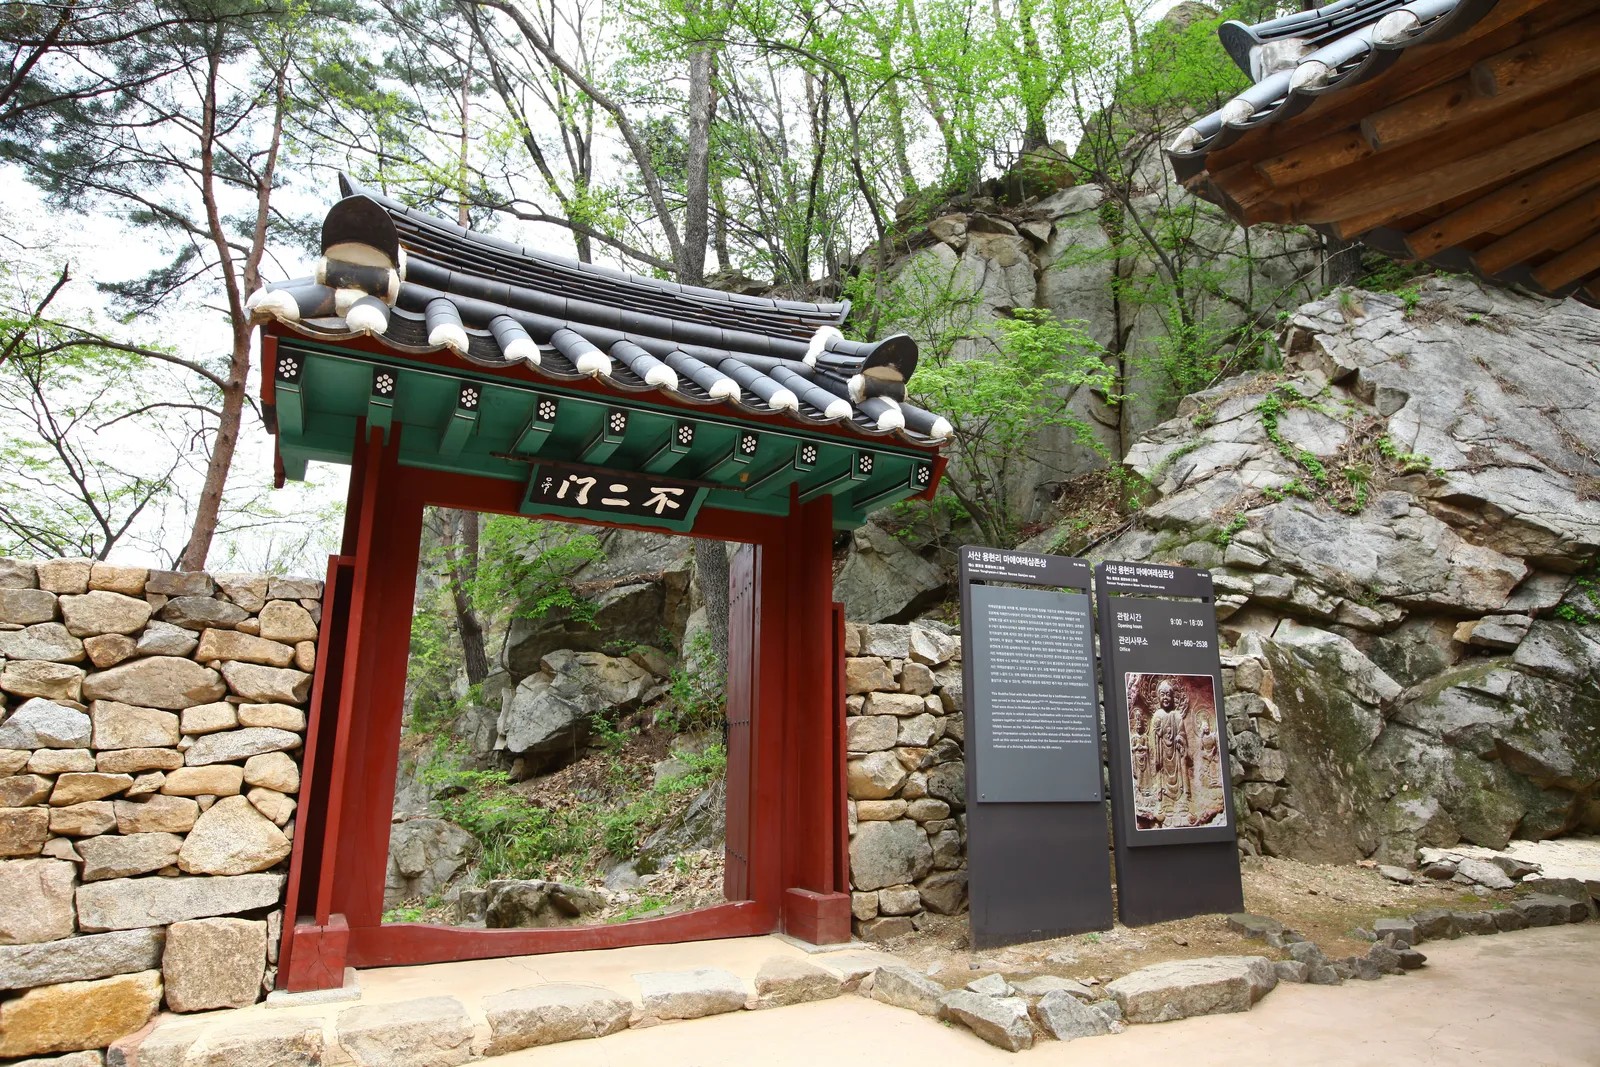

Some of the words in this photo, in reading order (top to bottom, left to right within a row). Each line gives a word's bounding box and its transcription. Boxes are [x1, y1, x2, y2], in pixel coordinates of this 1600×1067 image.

[967, 551, 981, 561] 서산
[982, 552, 1002, 563] 용현리
[1105, 564, 1117, 574] 서산
[1118, 565, 1135, 576] 용현리
[1117, 612, 1142, 622] 관람시간
[1170, 618, 1182, 626] 9:00
[1189, 619, 1204, 627] 18:00
[1119, 636, 1149, 646] 관리사무소
[1172, 639, 1208, 648] 041-660-2538
